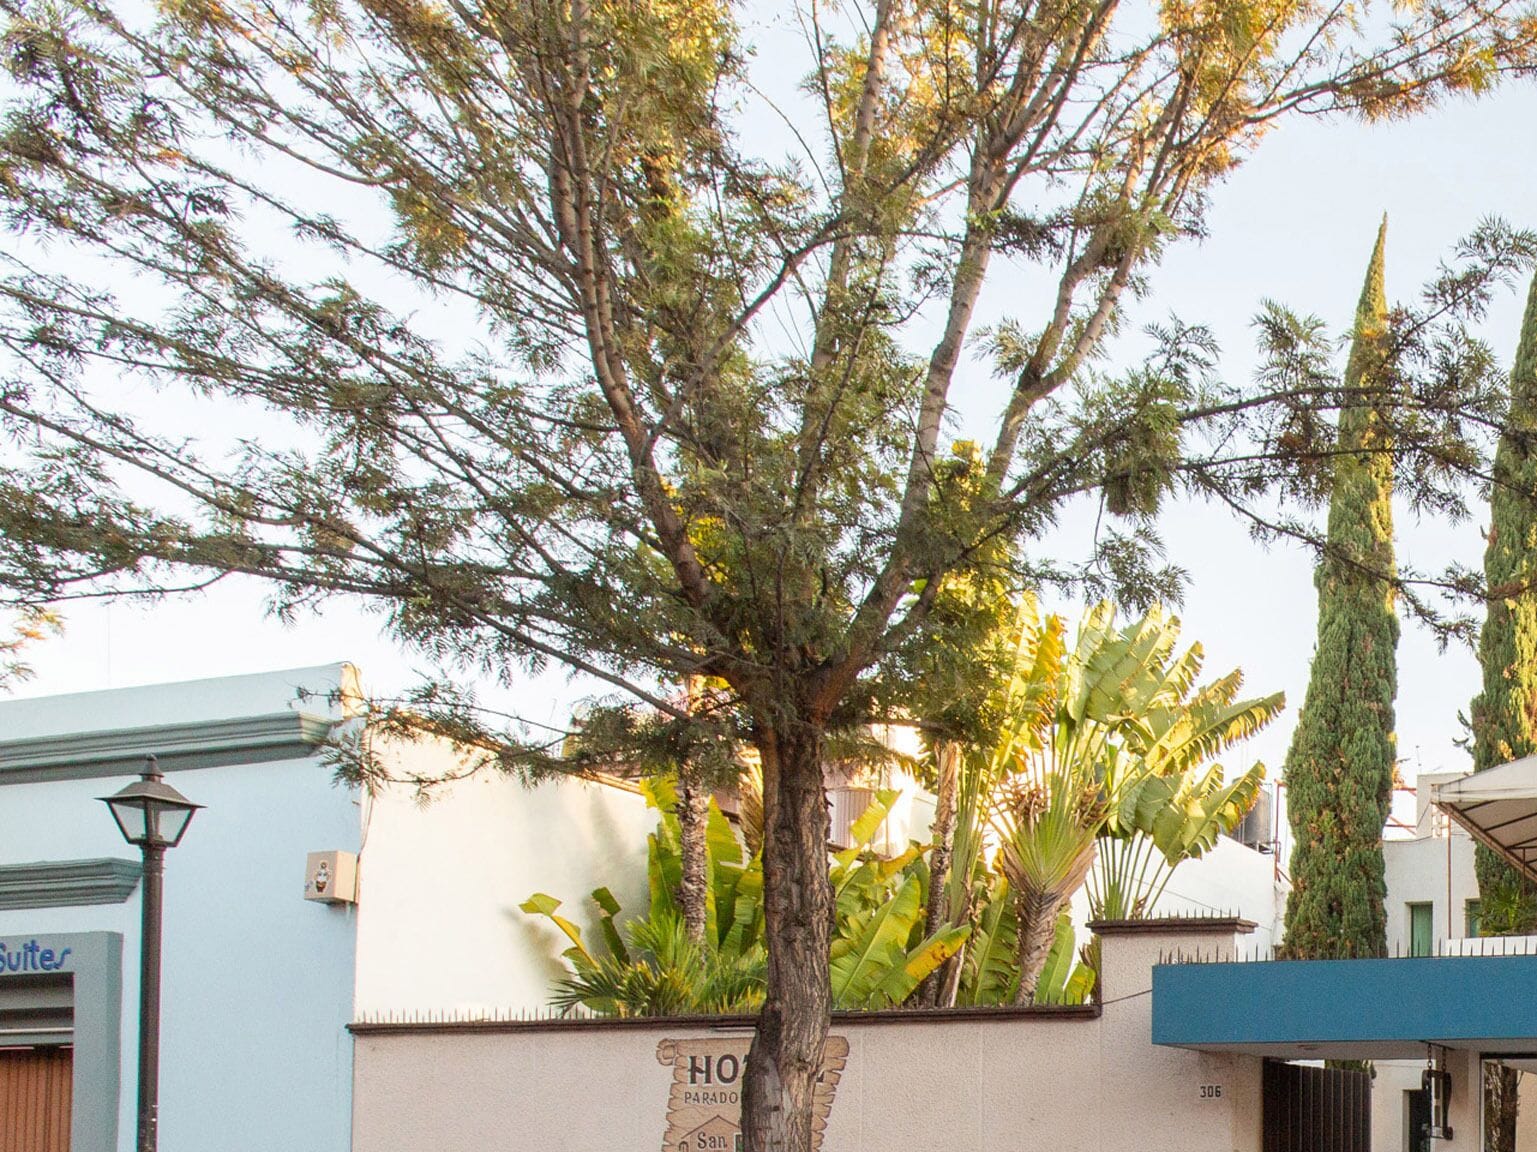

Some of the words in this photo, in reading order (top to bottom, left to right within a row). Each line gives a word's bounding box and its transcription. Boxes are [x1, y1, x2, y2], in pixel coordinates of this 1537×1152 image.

[1200, 1085, 1221, 1098] 306
[684, 1092, 739, 1105] PARADO
[697, 1131, 727, 1149] San
